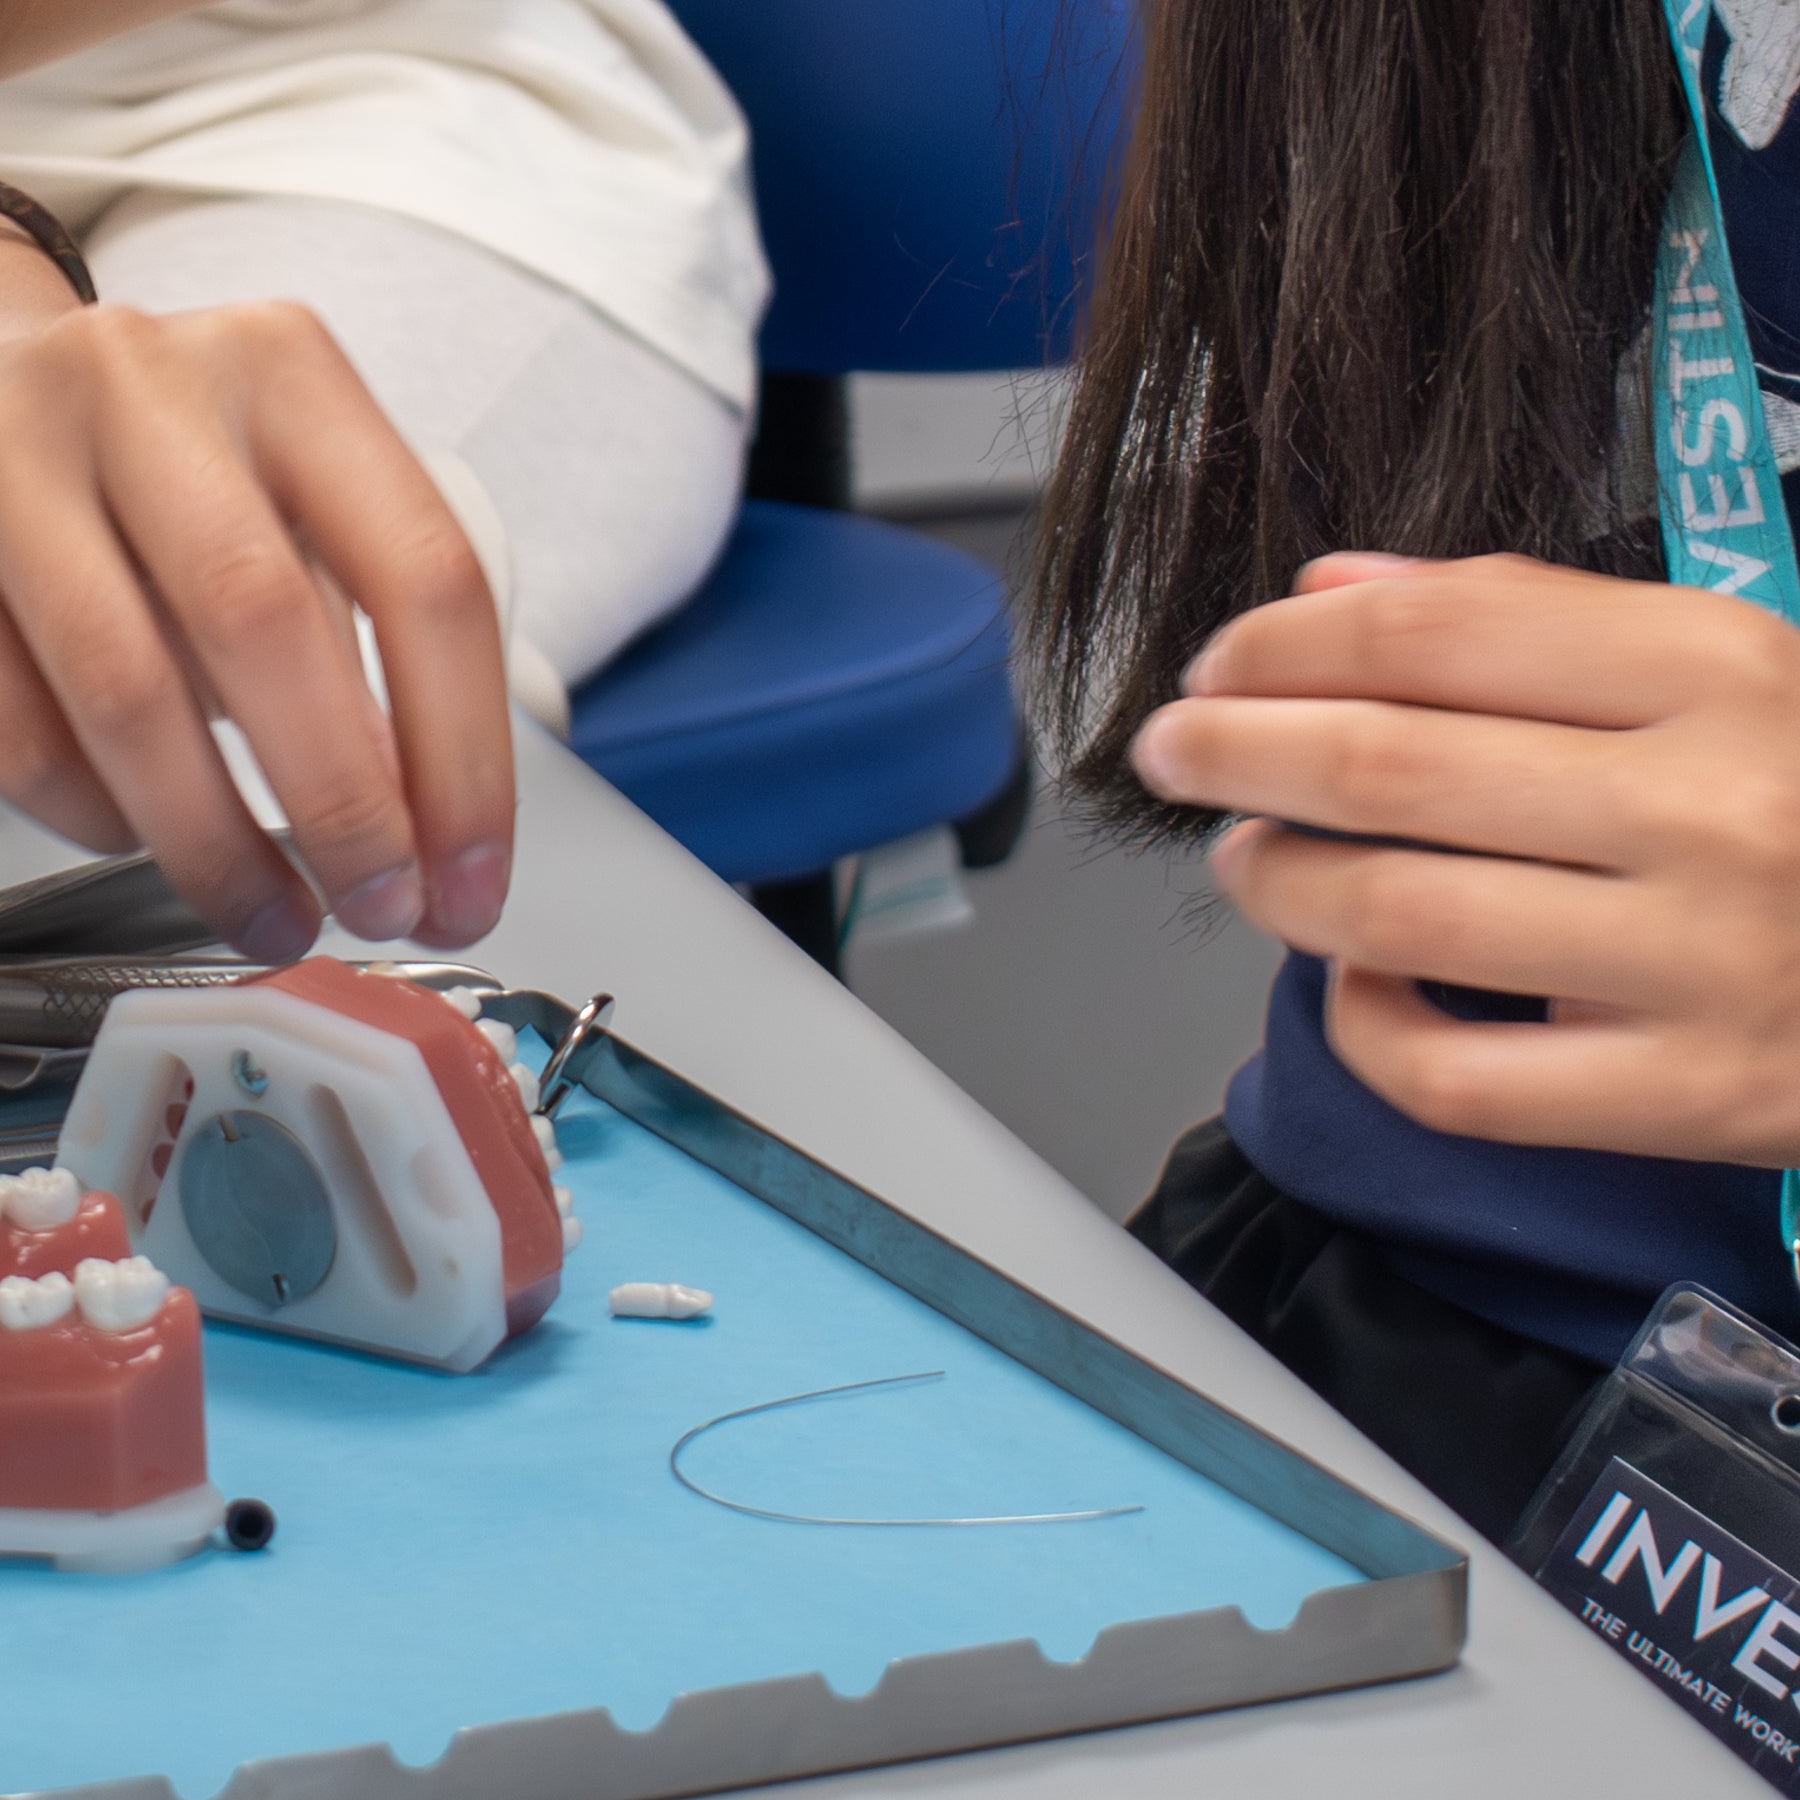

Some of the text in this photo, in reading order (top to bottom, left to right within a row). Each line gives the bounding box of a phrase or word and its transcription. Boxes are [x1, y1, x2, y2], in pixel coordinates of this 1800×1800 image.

[1667, 228, 1774, 595] VESTIN
[1581, 1596, 1627, 1639] THE
[1626, 1630, 1732, 1714] ULTIMATE
